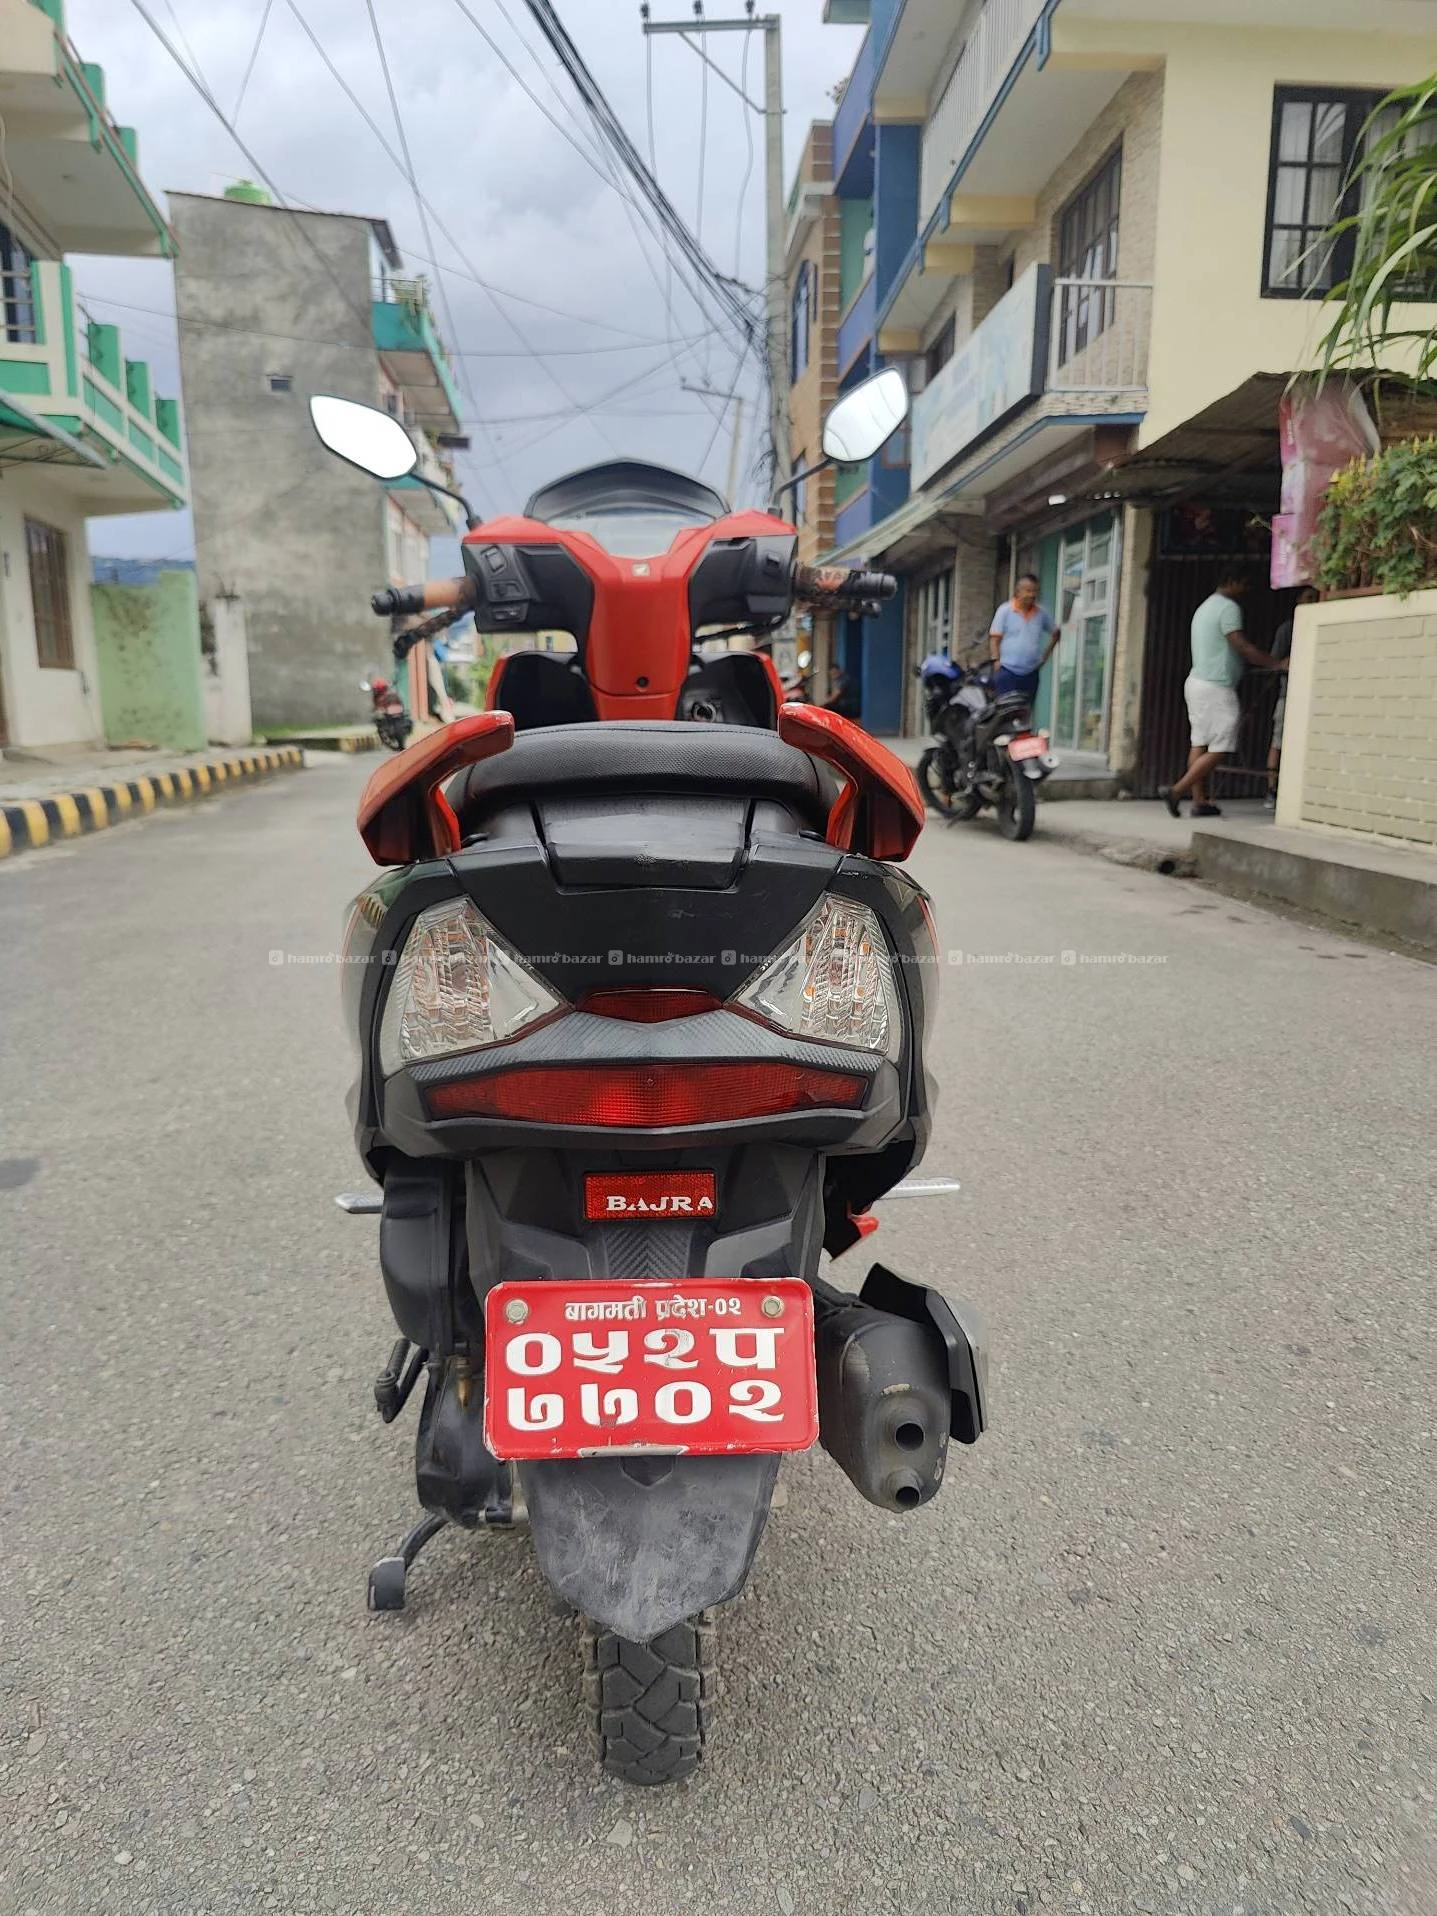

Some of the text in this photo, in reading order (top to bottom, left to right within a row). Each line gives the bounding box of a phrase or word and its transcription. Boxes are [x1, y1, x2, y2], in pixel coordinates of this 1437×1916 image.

[605, 1195, 714, 1212] BAJRA
[564, 1295, 647, 1321] बागमती
[506, 1379, 785, 1431] ७७०२
